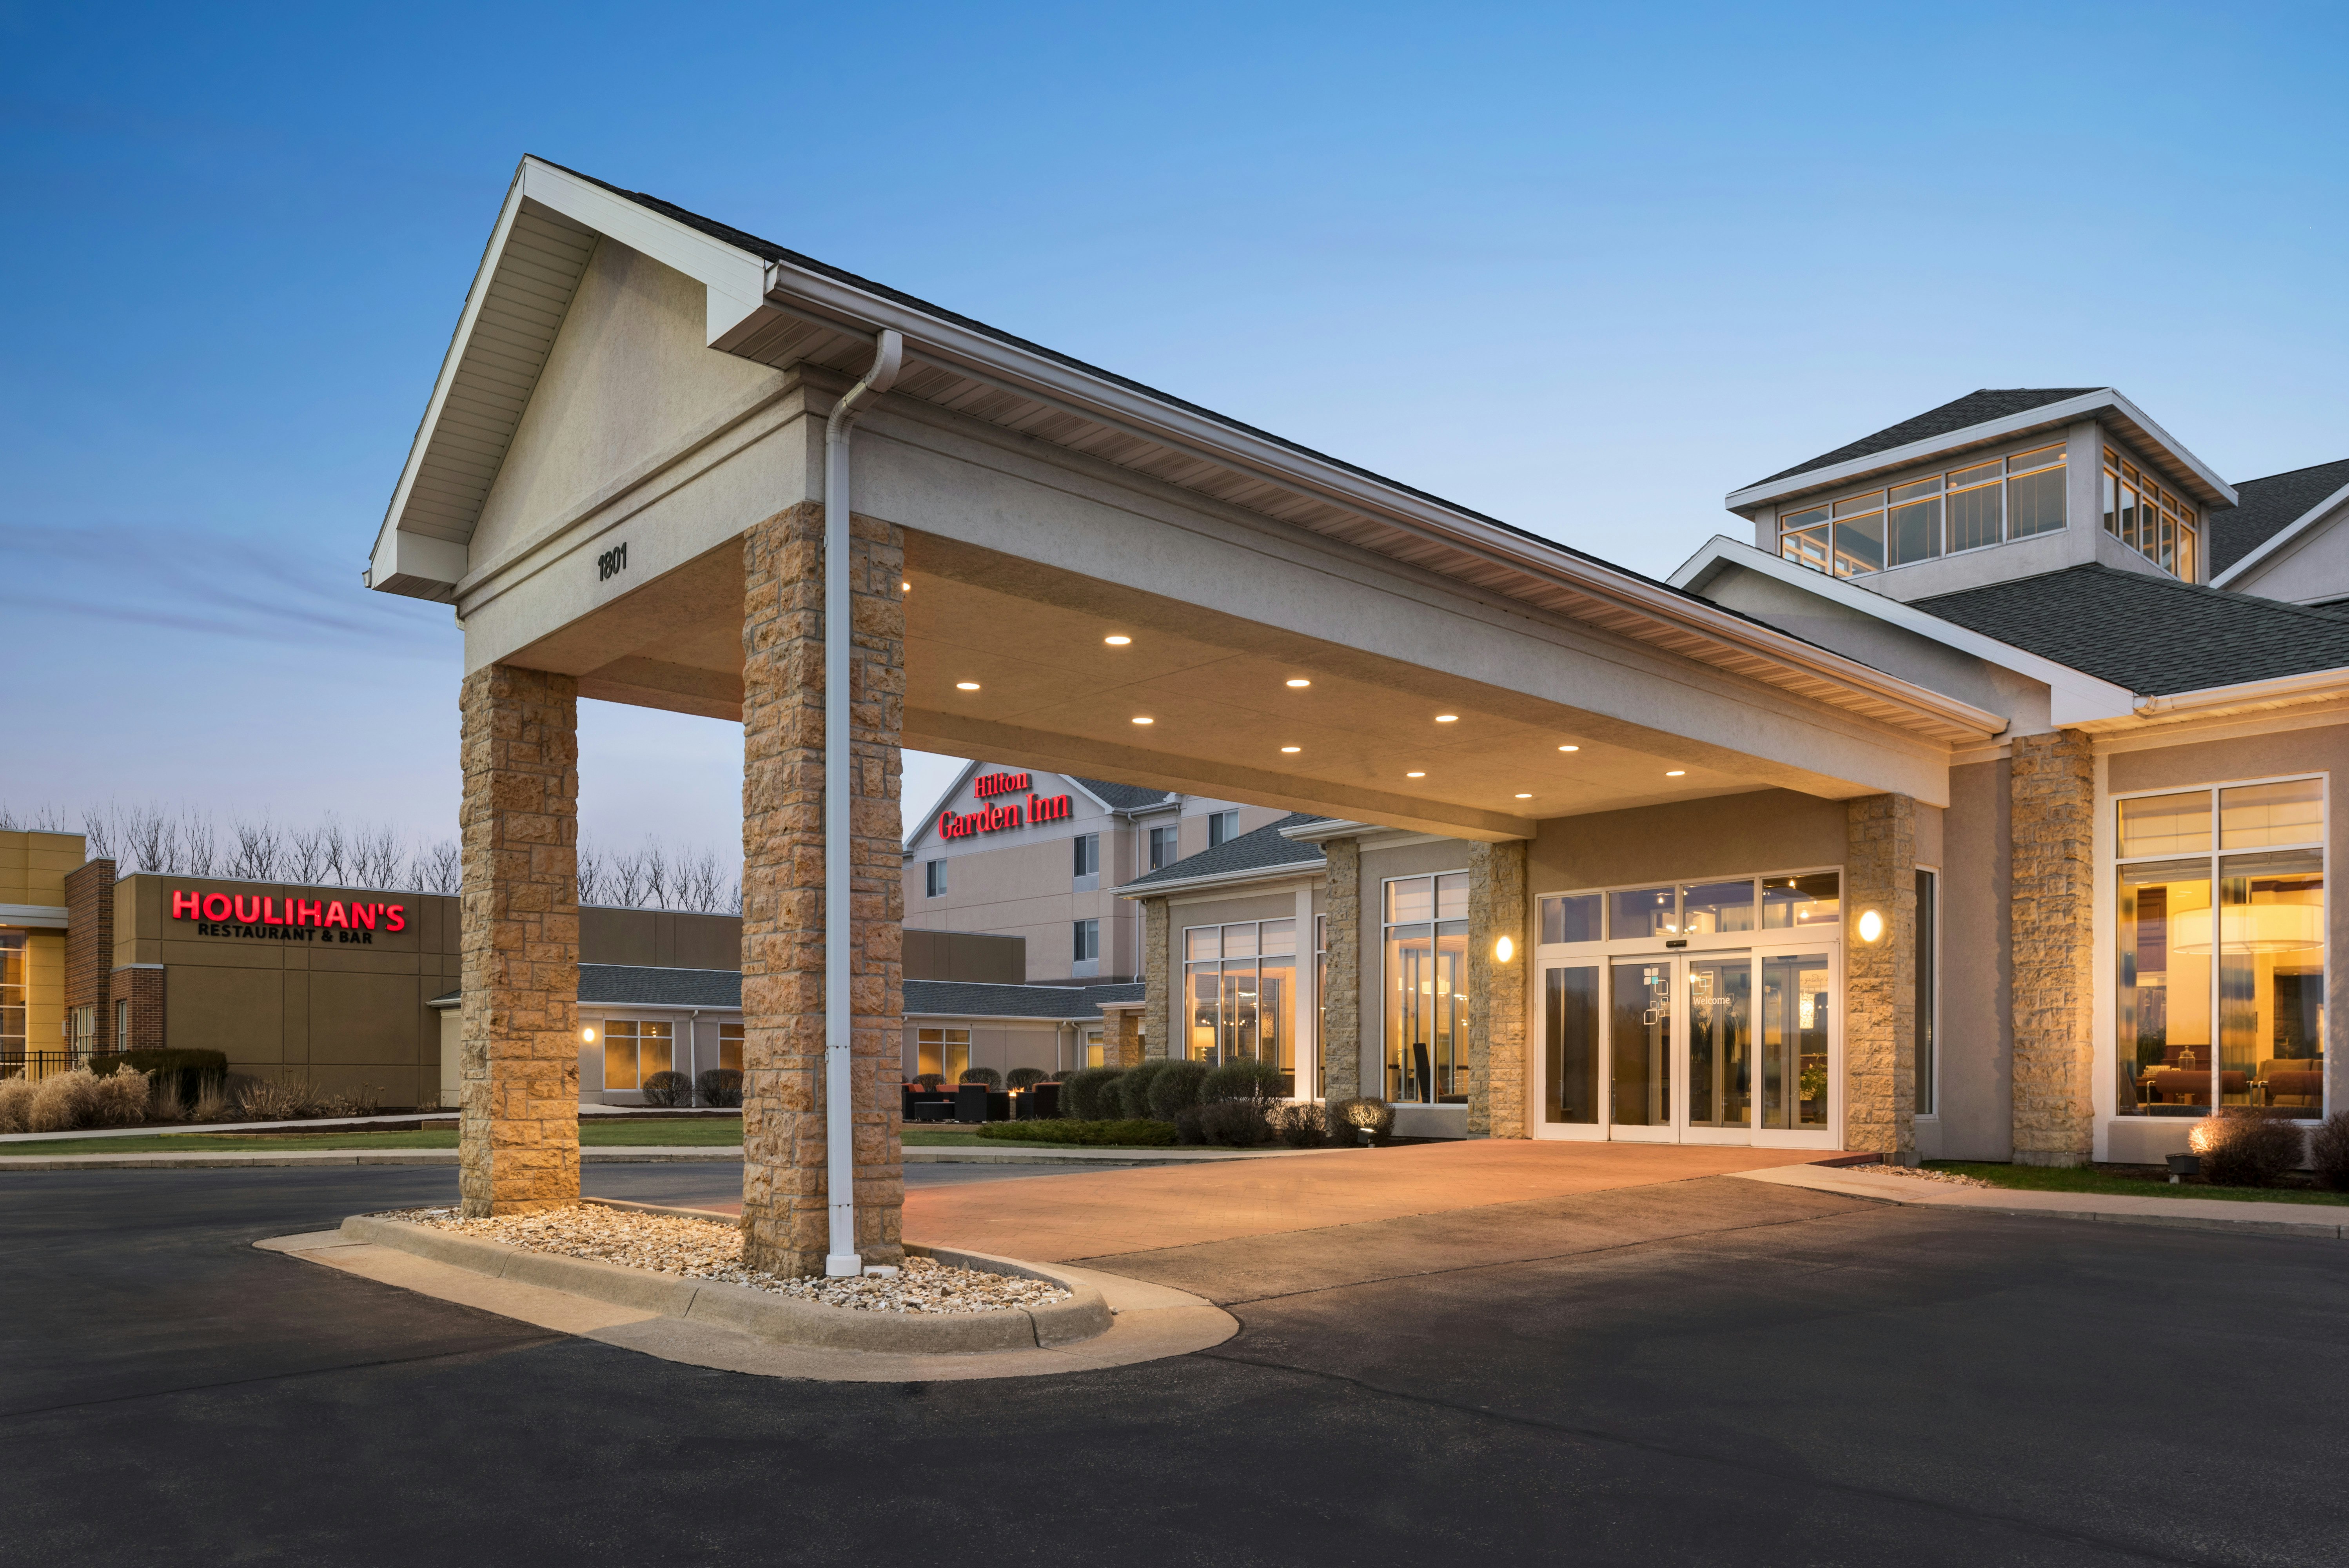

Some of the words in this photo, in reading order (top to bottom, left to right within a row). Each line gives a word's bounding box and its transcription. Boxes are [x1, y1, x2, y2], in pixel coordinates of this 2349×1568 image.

[597, 541, 627, 581] 1801
[974, 771, 1029, 798] Hilton
[938, 802, 1020, 840] Garden
[1025, 793, 1070, 824] Inn
[172, 890, 405, 931] HOULIHAN'S
[198, 923, 315, 941] RESTAURANT
[321, 930, 333, 942] &
[339, 931, 372, 944] BAR
[1693, 996, 1730, 1005] Welcome
